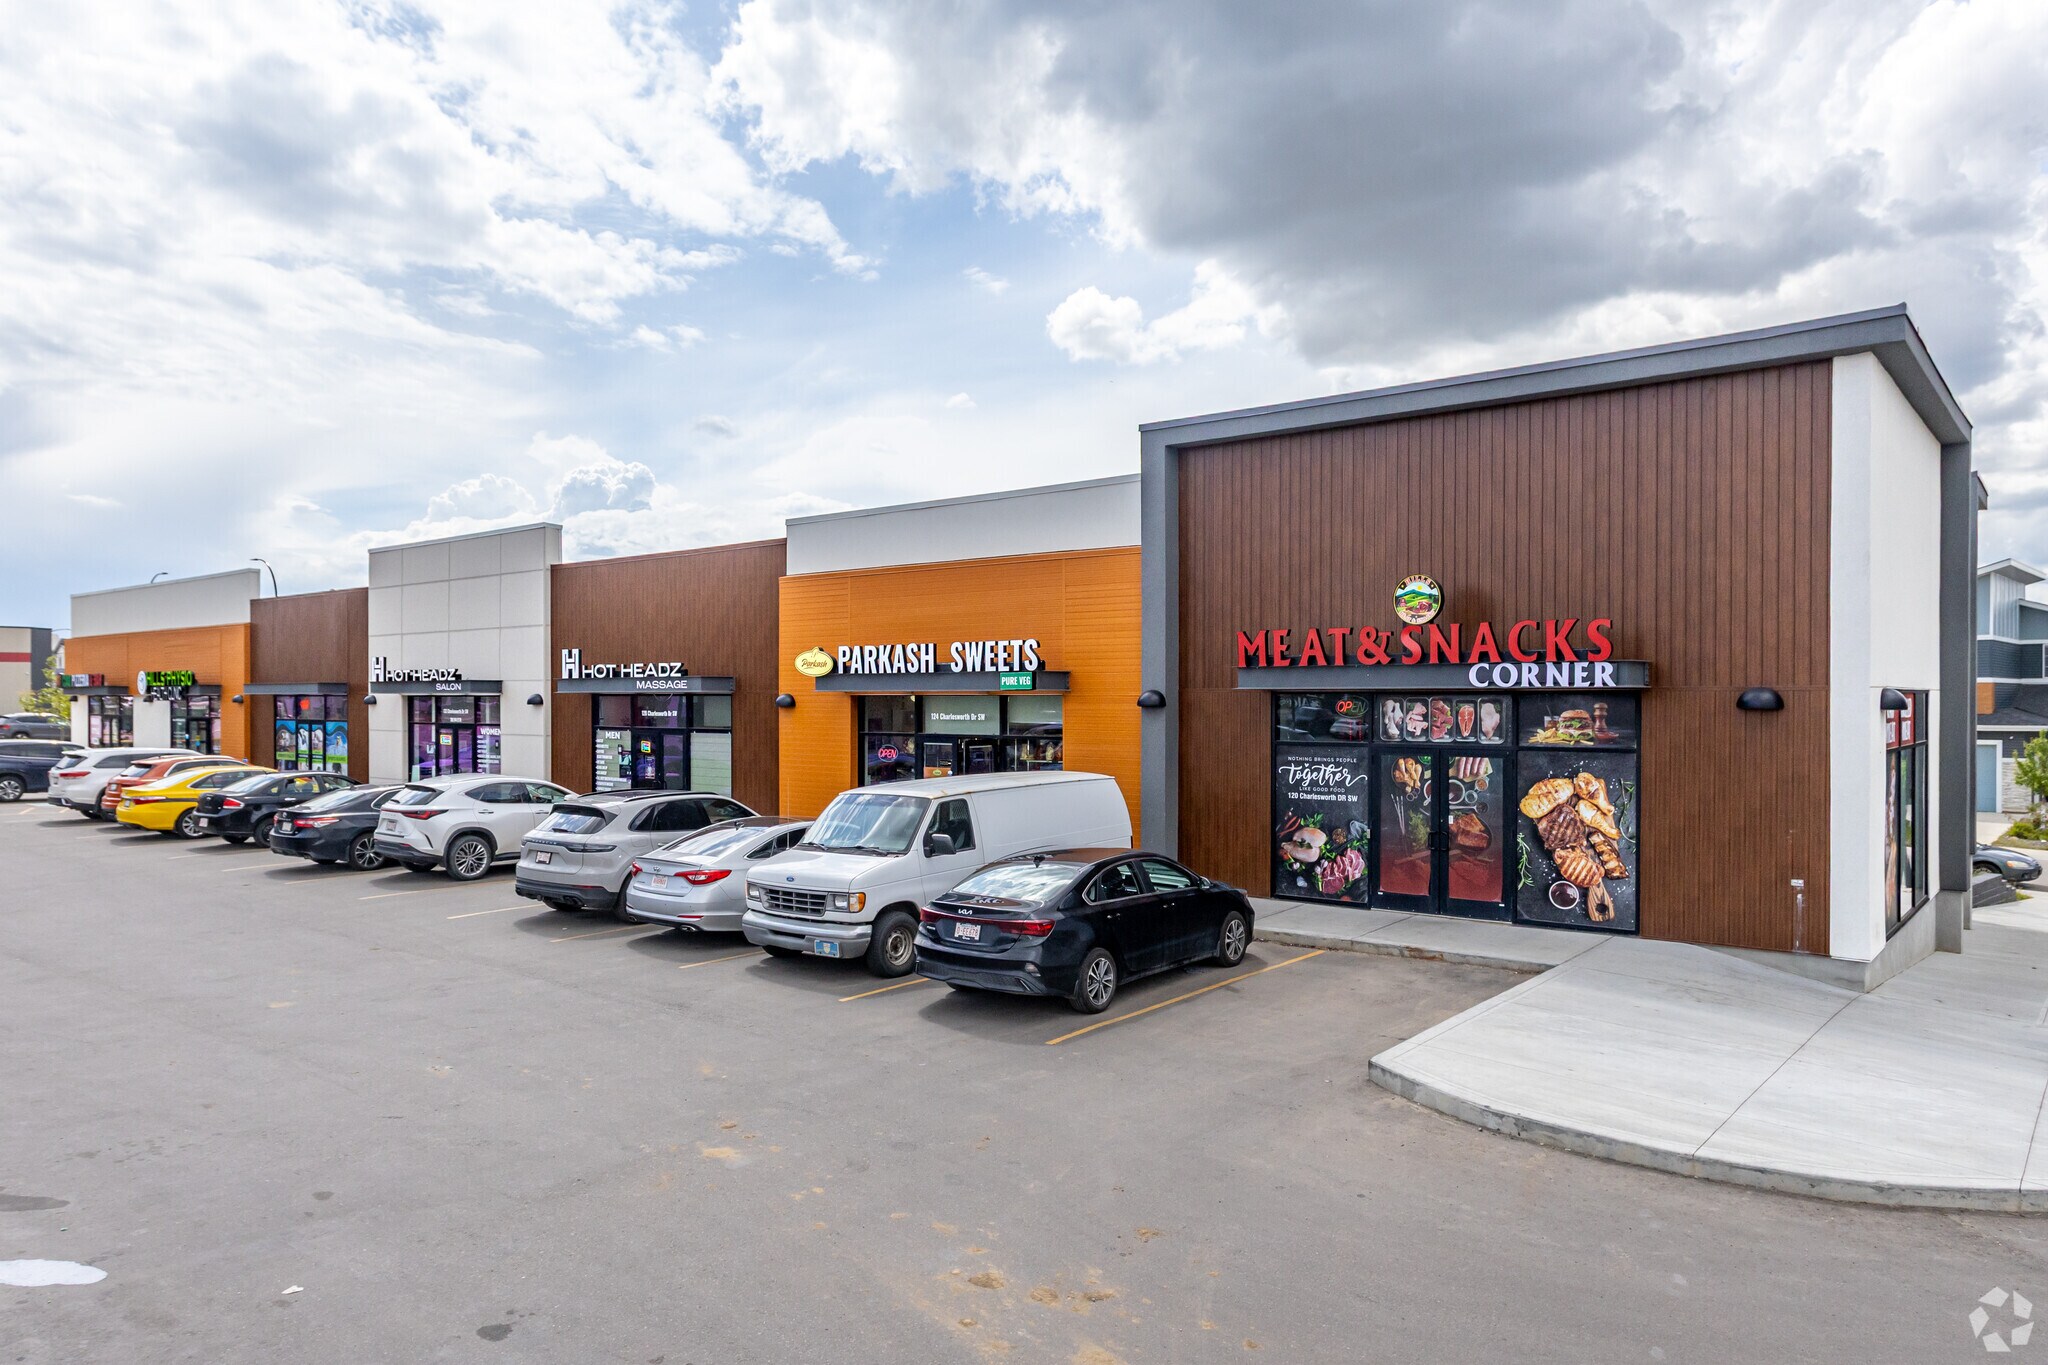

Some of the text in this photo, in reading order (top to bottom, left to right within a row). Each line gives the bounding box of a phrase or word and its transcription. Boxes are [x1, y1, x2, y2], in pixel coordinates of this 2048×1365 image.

[838, 638, 1039, 675] PARKASH SWEETS
[801, 658, 828, 669] Parkash
[386, 669, 411, 682] HOT
[412, 668, 456, 681] HEADZ
[582, 663, 617, 679] HOT
[620, 662, 682, 678] HEADZ
[1468, 662, 1618, 688] CORNER
[636, 680, 688, 690] MASSAGE
[1001, 675, 1031, 686] PURE VEG
[435, 682, 462, 691] SALON
[1337, 701, 1365, 713] OPEN
[930, 712, 939, 720] 124
[940, 712, 970, 721] Charlesworth
[977, 713, 985, 721] SW
[480, 727, 501, 736] WOMEN
[605, 731, 621, 739] MEN
[879, 748, 897, 759] OPEN
[1278, 762, 1368, 787] together
[1299, 792, 1337, 801] Charlesworth
[1337, 794, 1347, 802] DR
[1347, 794, 1358, 802] SW
